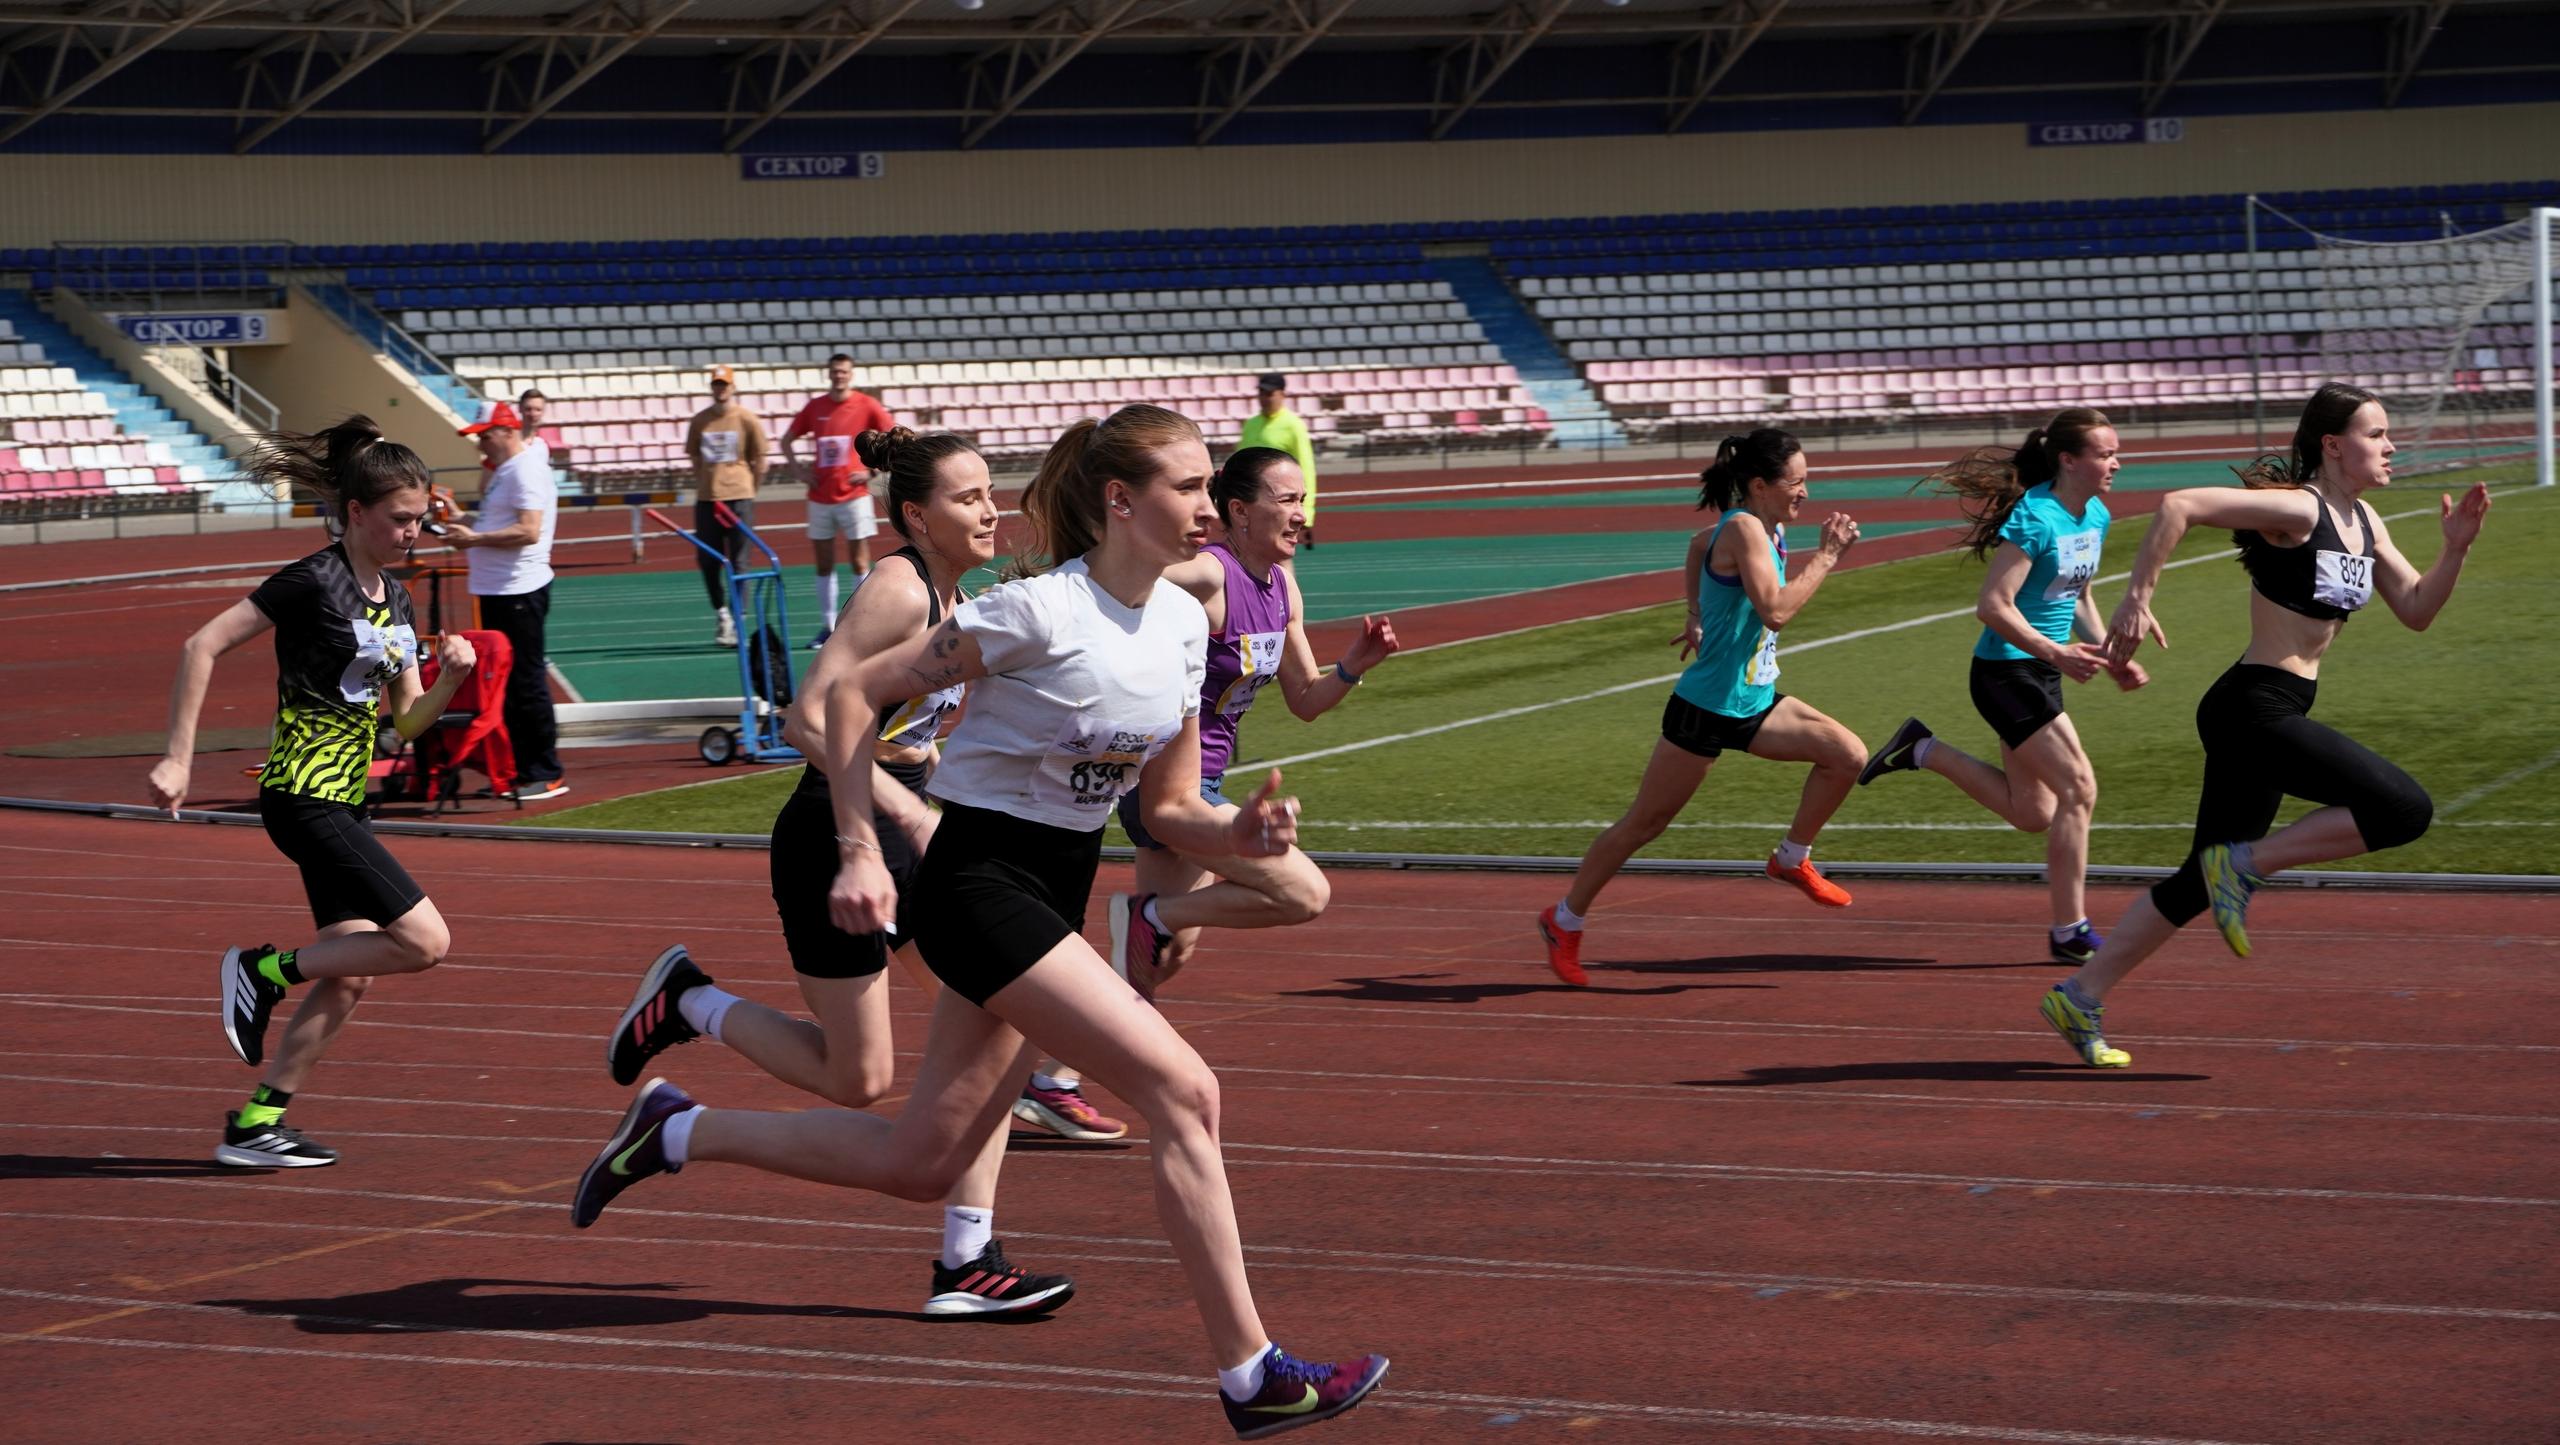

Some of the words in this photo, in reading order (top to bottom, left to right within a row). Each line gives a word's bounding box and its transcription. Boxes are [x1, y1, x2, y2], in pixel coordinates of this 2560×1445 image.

[2041, 123, 2134, 143] СЕКТОР
[2152, 118, 2180, 140] 10
[754, 157, 849, 176] СЕКТОР
[864, 154, 880, 176] 9
[250, 317, 263, 338] 9
[2340, 555, 2366, 588] 892
